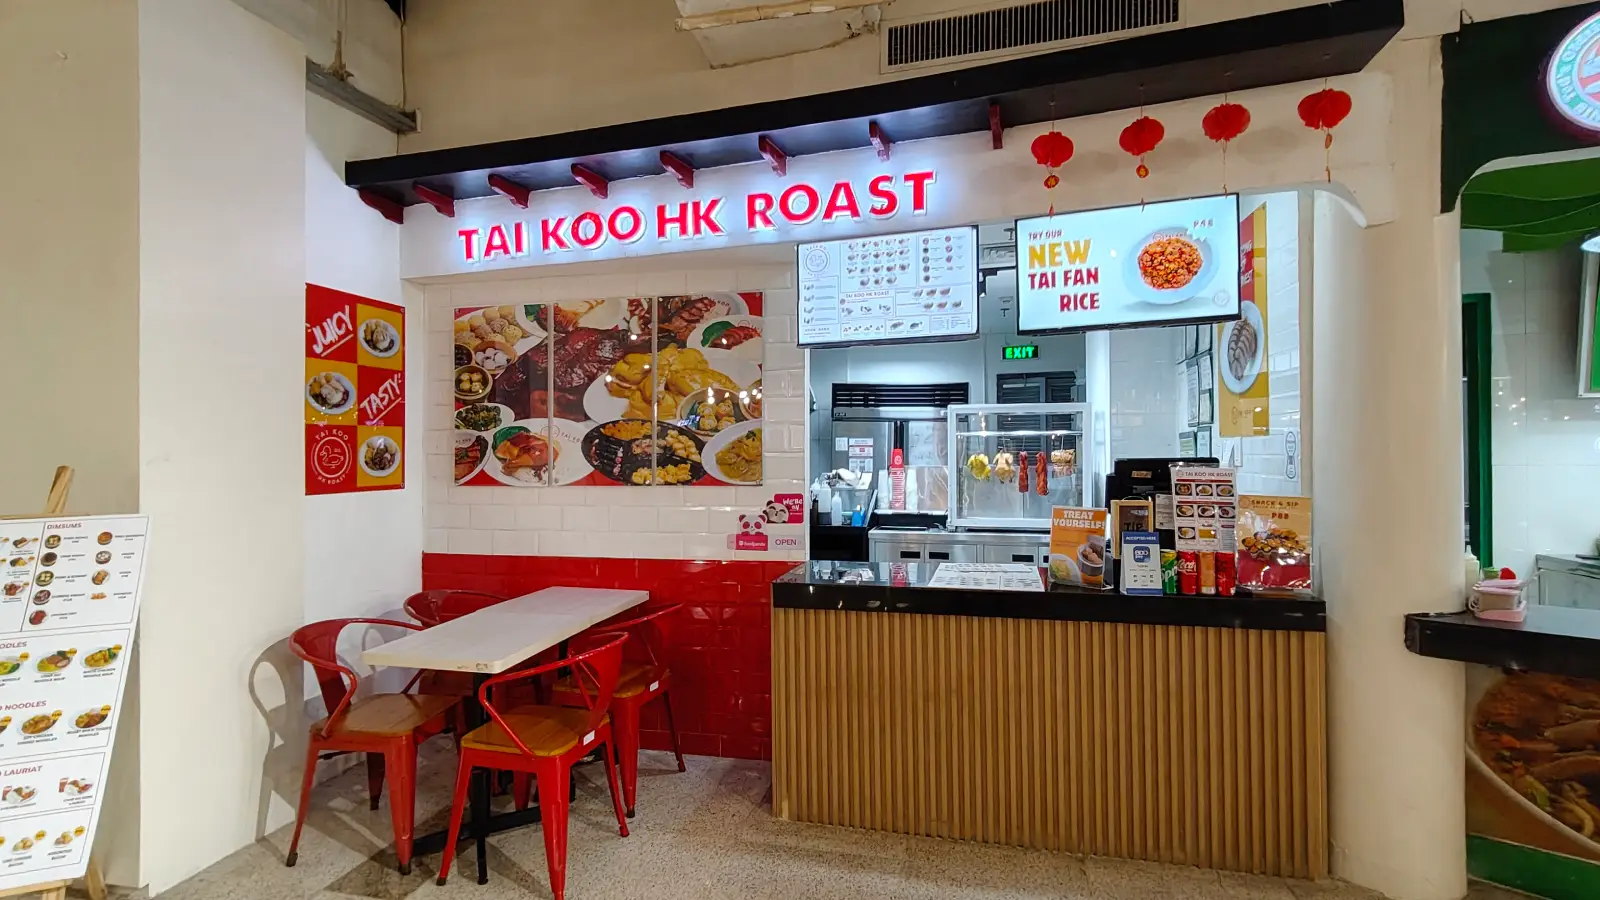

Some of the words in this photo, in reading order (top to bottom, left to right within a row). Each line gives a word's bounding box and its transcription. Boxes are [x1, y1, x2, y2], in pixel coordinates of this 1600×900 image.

[458, 221, 529, 263] TAI
[541, 204, 645, 252] KOO
[656, 196, 724, 240] HK
[747, 170, 937, 232] ROAST
[1028, 231, 1043, 241] TRY
[1045, 229, 1063, 238] OUR
[1028, 238, 1092, 269] NEW
[1028, 272, 1057, 290] TAI
[1063, 267, 1100, 286] FAN
[1059, 292, 1101, 312] RICE
[312, 304, 353, 354] JUICY
[1005, 346, 1035, 359] EXIT
[315, 429, 329, 440] TAI
[332, 429, 349, 441] KOO
[1063, 509, 1094, 520] TREAT
[47, 522, 82, 530] DIMSUMS
[1053, 518, 1105, 529] YOURSELF!
[1123, 521, 1144, 532] TIP
[774, 538, 797, 547] OPEN
[5, 700, 47, 710] NOODLES
[4, 765, 43, 777] LAURIAT
